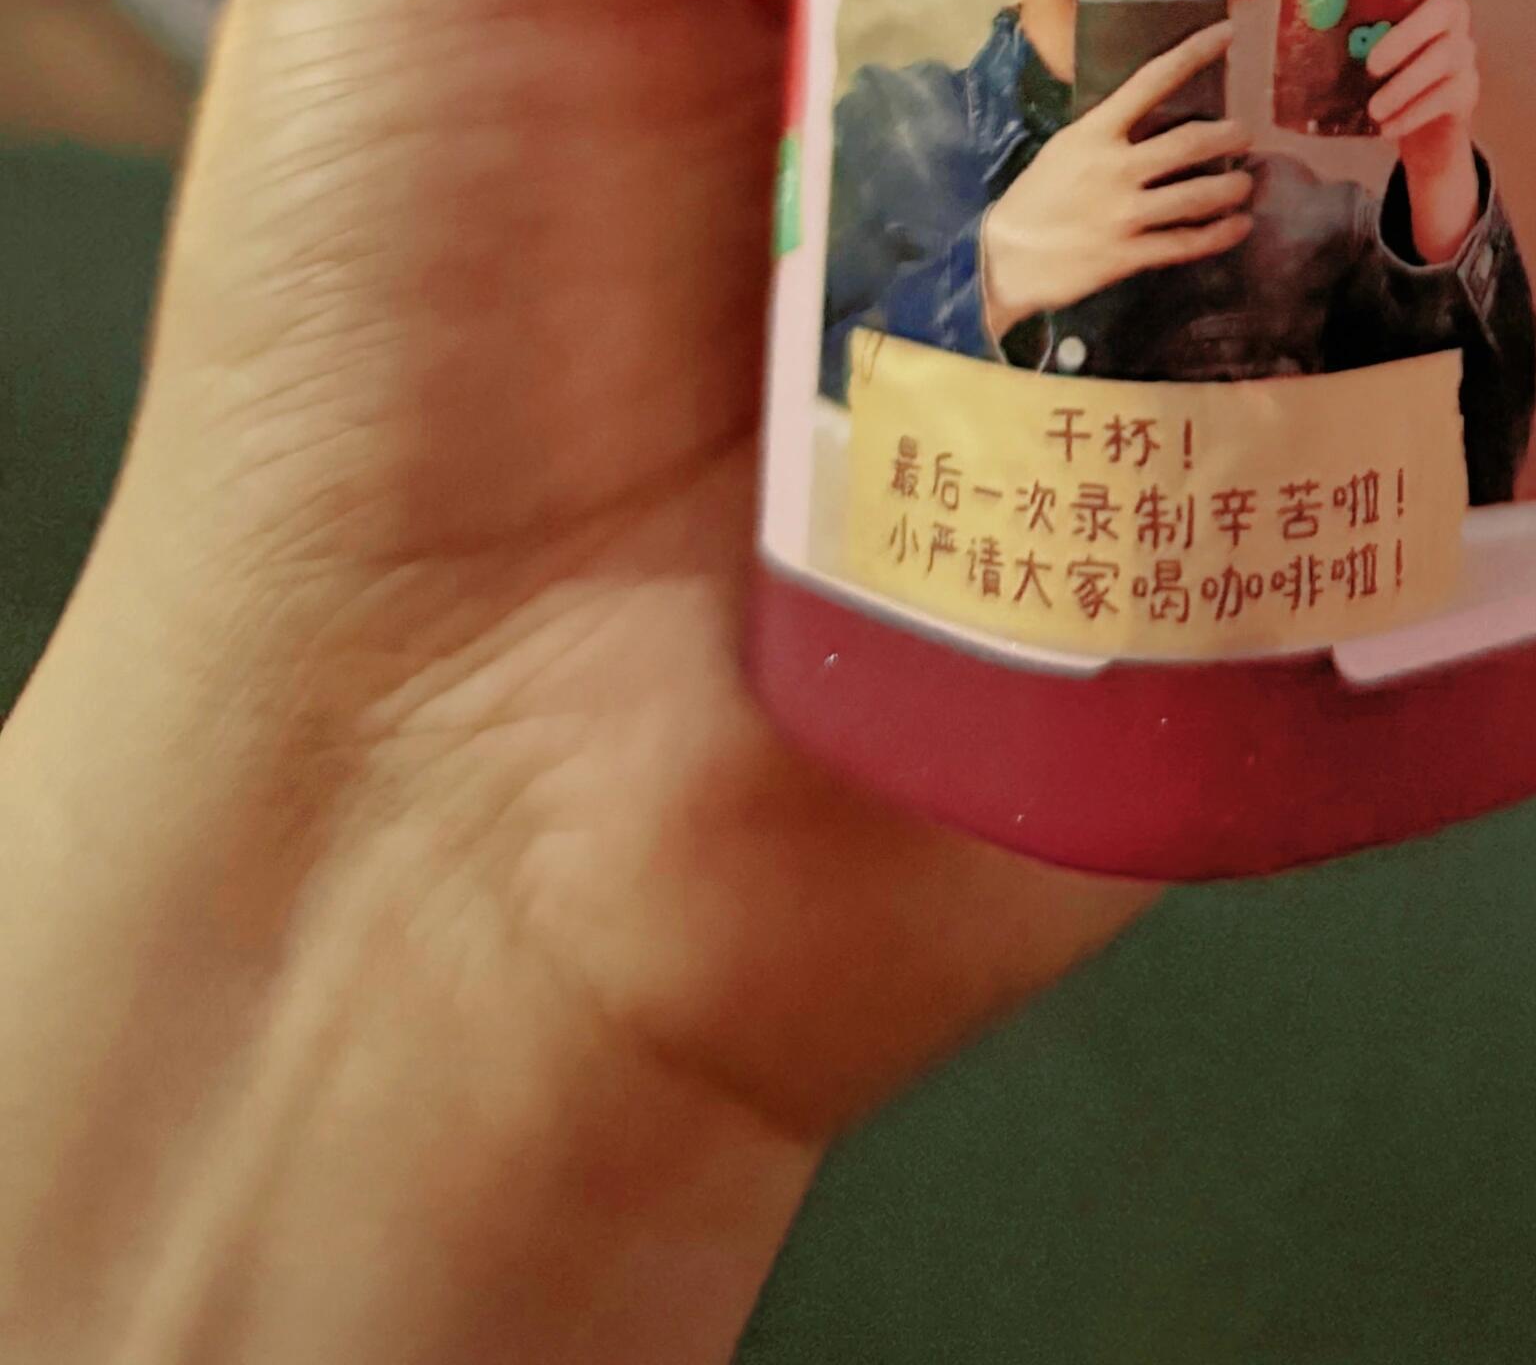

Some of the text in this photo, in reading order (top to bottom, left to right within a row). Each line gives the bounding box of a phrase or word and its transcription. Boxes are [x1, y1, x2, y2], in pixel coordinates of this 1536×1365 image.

[889, 435, 1404, 550] 最后一次录制辛苦啦！
[1046, 407, 1192, 470] 干杯！
[888, 515, 1402, 623] 小严请大家喝咖啡啦！
